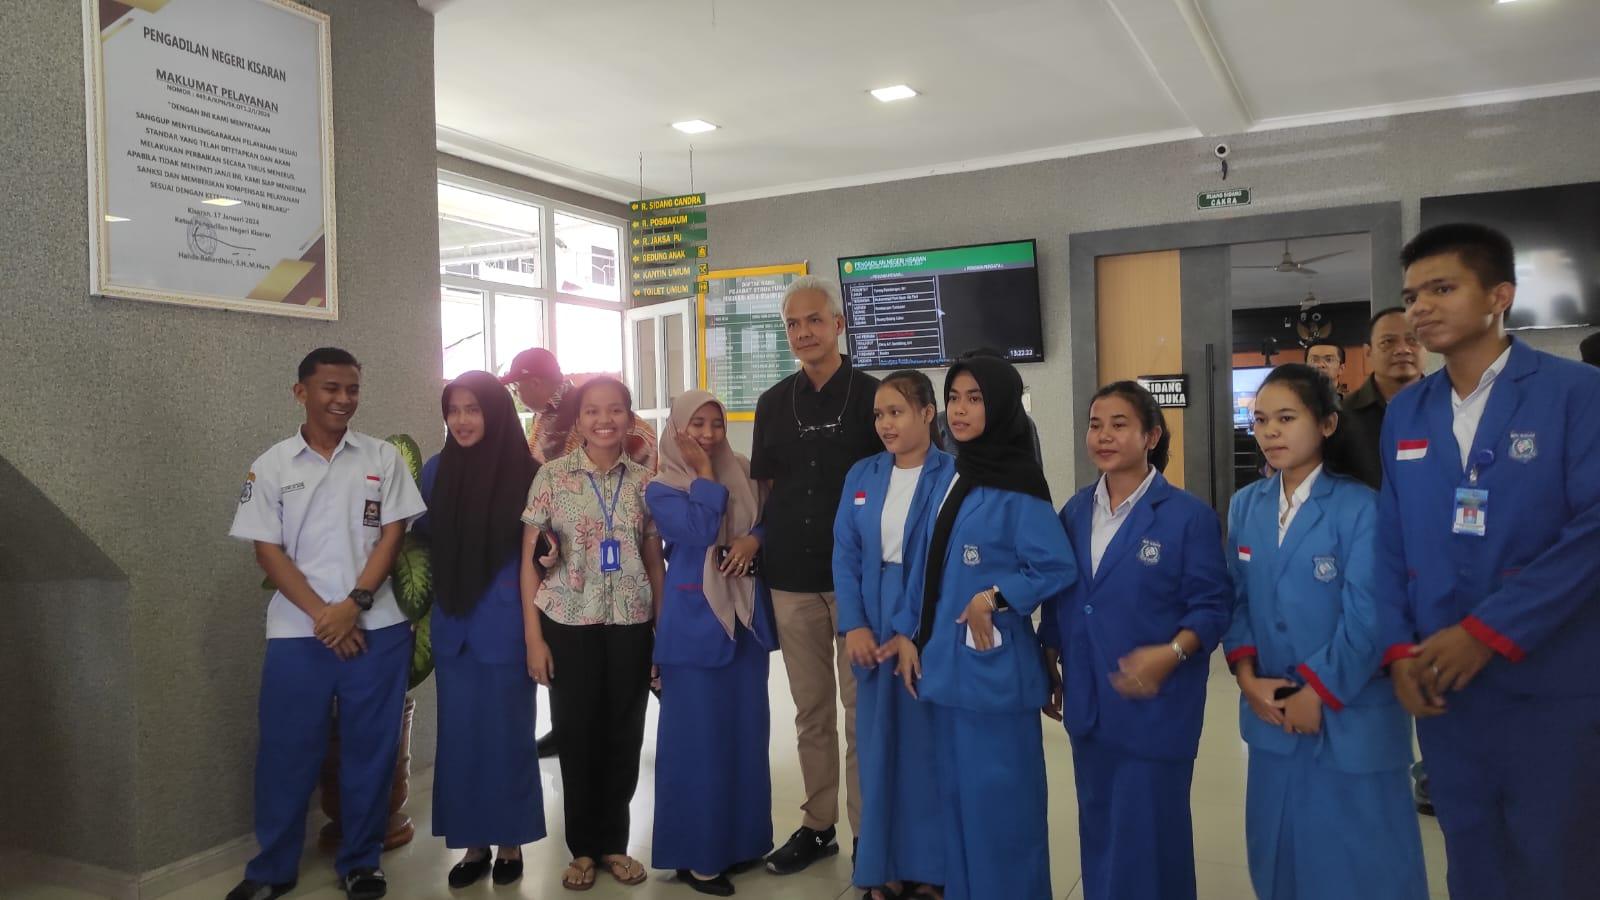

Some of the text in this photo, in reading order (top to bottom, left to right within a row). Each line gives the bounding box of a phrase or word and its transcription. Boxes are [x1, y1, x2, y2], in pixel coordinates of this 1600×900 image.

[144, 26, 286, 82] PENGADILAN NEGERI KISARAN
[156, 68, 278, 113] MAKLUMAT PELAYANAN
[167, 84, 192, 96] NOMOR
[201, 110, 210, 118] INI
[212, 113, 228, 124] KAMI
[230, 118, 270, 134] MENYATAKAN
[136, 112, 298, 157] SANGGUP MENYELENGGARAKAN PELAYANAN SESUAI
[140, 139, 294, 180] MELAKUKAN PERBAIKAN SECARA TERUS MENERUS
[146, 128, 290, 167] STANDAR YANG TELAH DITETAPKAN DAN AKAN
[127, 150, 156, 162] APABILA
[159, 156, 179, 167] TIDAK
[180, 162, 212, 174] MENEPATI
[214, 170, 231, 179] JANJI
[244, 176, 260, 185] KAMI
[276, 182, 306, 194] MENERIMA
[137, 166, 162, 176] SANKSI
[164, 171, 180, 180] DAN
[181, 174, 224, 190] MEMBERIKAN
[266, 192, 300, 204] PELAYANAN
[150, 181, 174, 192] SESUAI
[176, 187, 204, 198] DENGAN
[244, 200, 260, 208] YANG
[649, 200, 672, 209] SIDANG
[675, 195, 701, 206] CANDRA
[1211, 197, 1237, 206] CAKRA
[650, 215, 688, 226] POSBAKUM
[642, 237, 649, 245] R.
[651, 234, 670, 245] JAKSA
[643, 250, 686, 262] GEDUNG ANAK
[643, 267, 690, 279] KANTIN UMUM
[643, 285, 688, 296] TOILET UMUM
